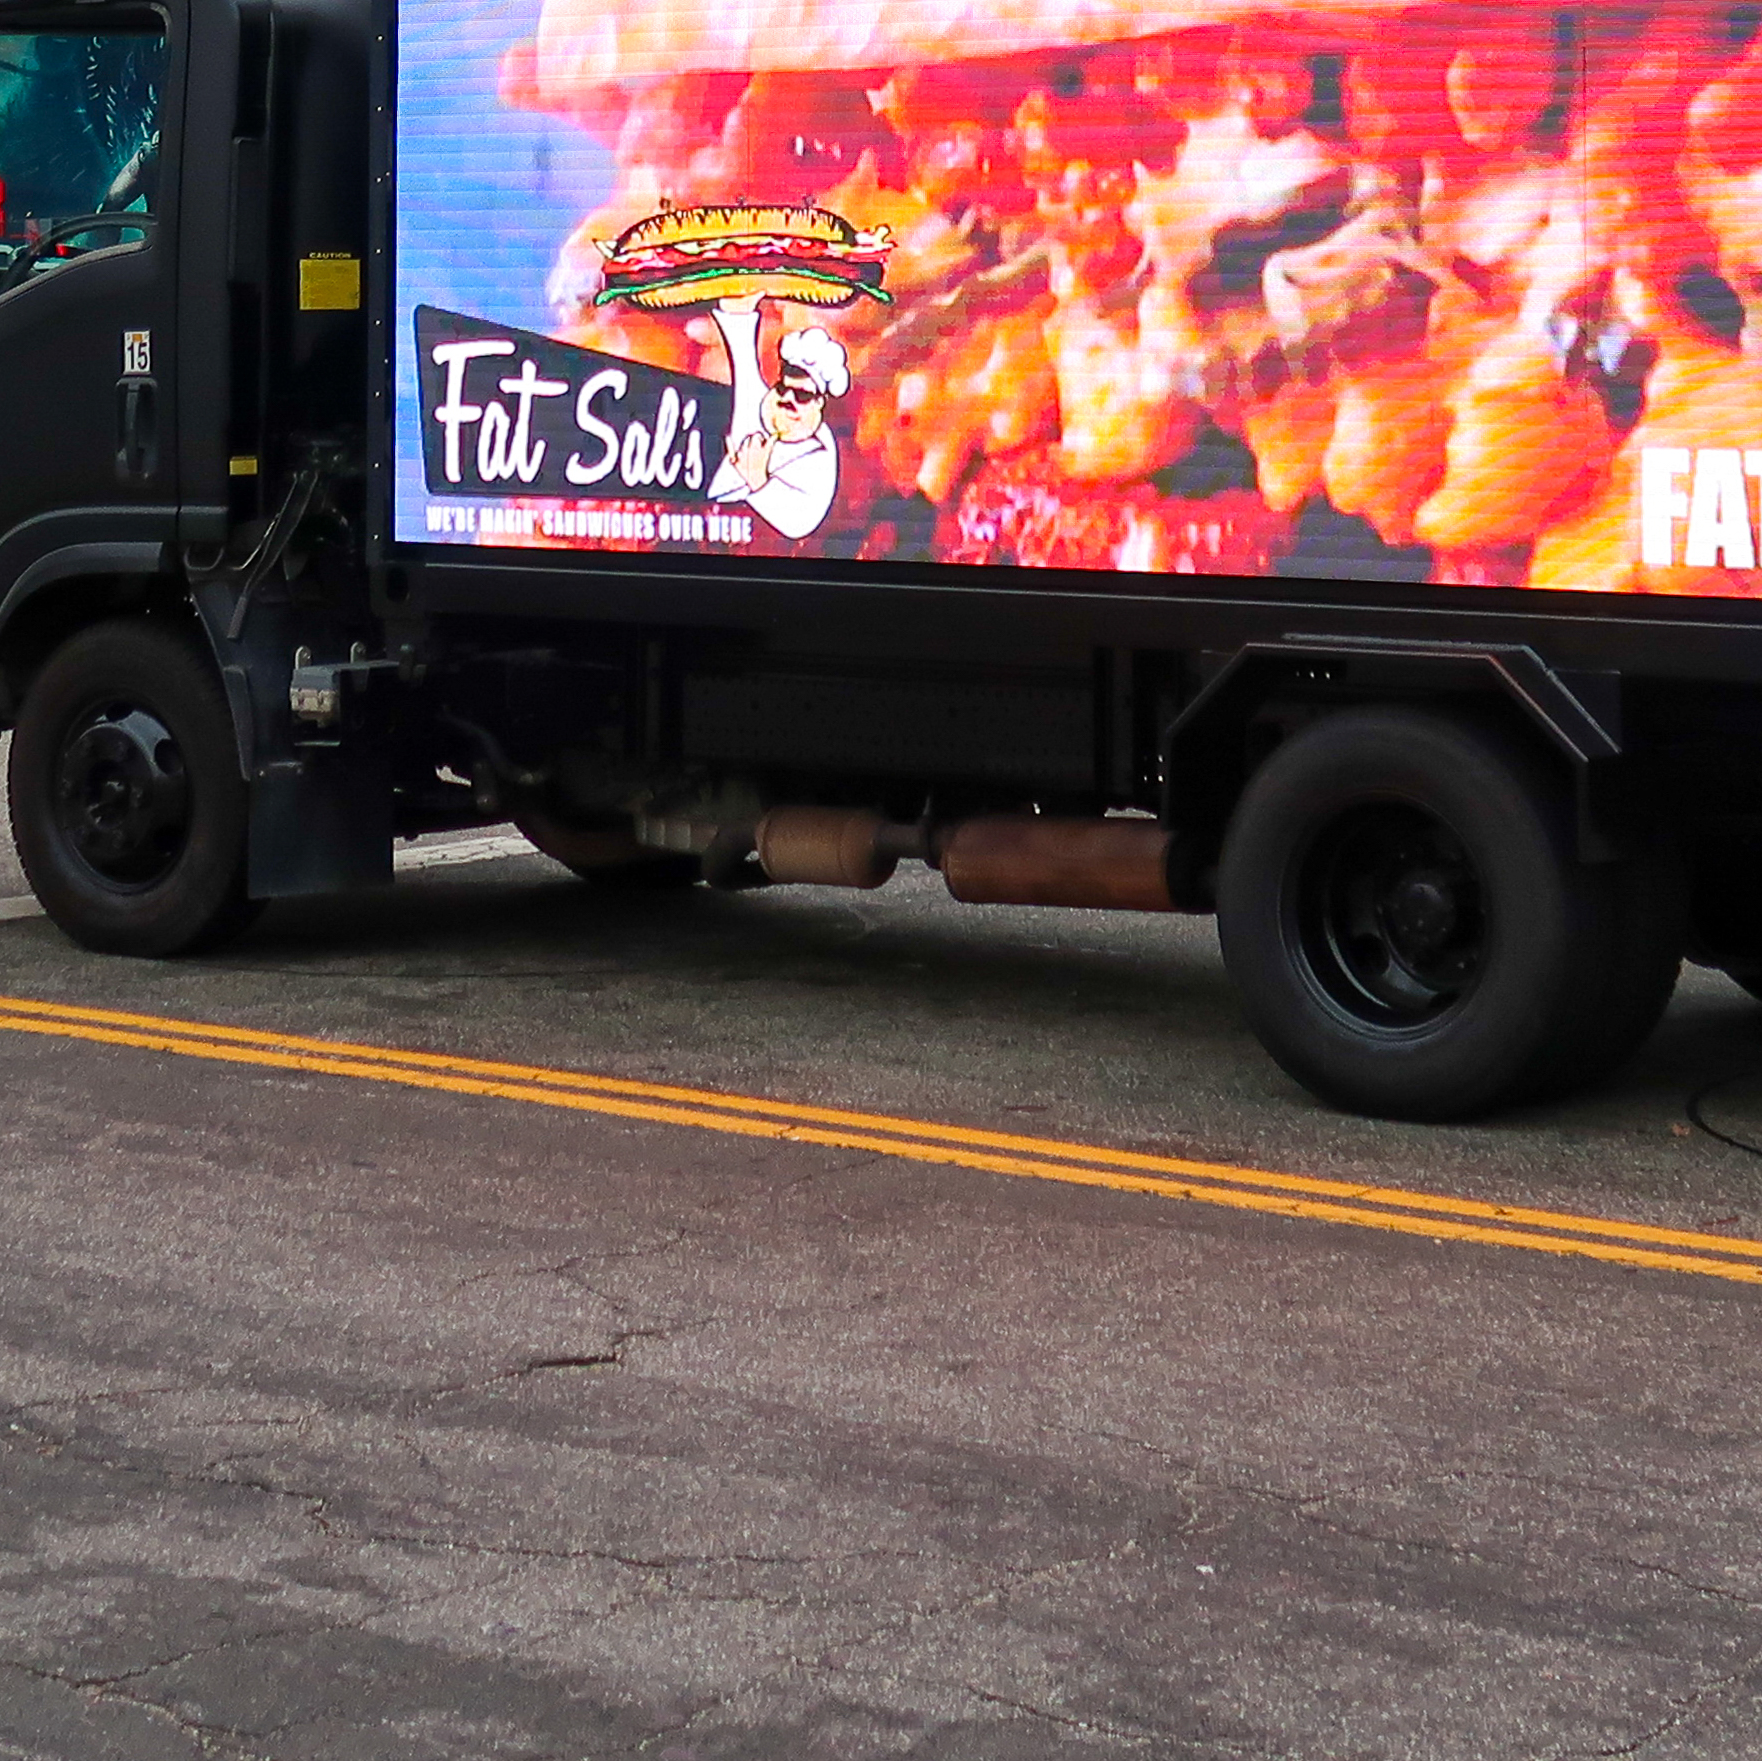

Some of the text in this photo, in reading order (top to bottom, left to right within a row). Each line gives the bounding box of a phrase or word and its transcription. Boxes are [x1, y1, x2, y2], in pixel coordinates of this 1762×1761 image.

[308, 252, 352, 260] CAUTION
[127, 341, 148, 370] 15
[432, 339, 705, 491] Fat Sal's
[541, 509, 655, 539] SANDWICHES
[658, 513, 705, 542] OVER
[707, 515, 753, 544] HERE
